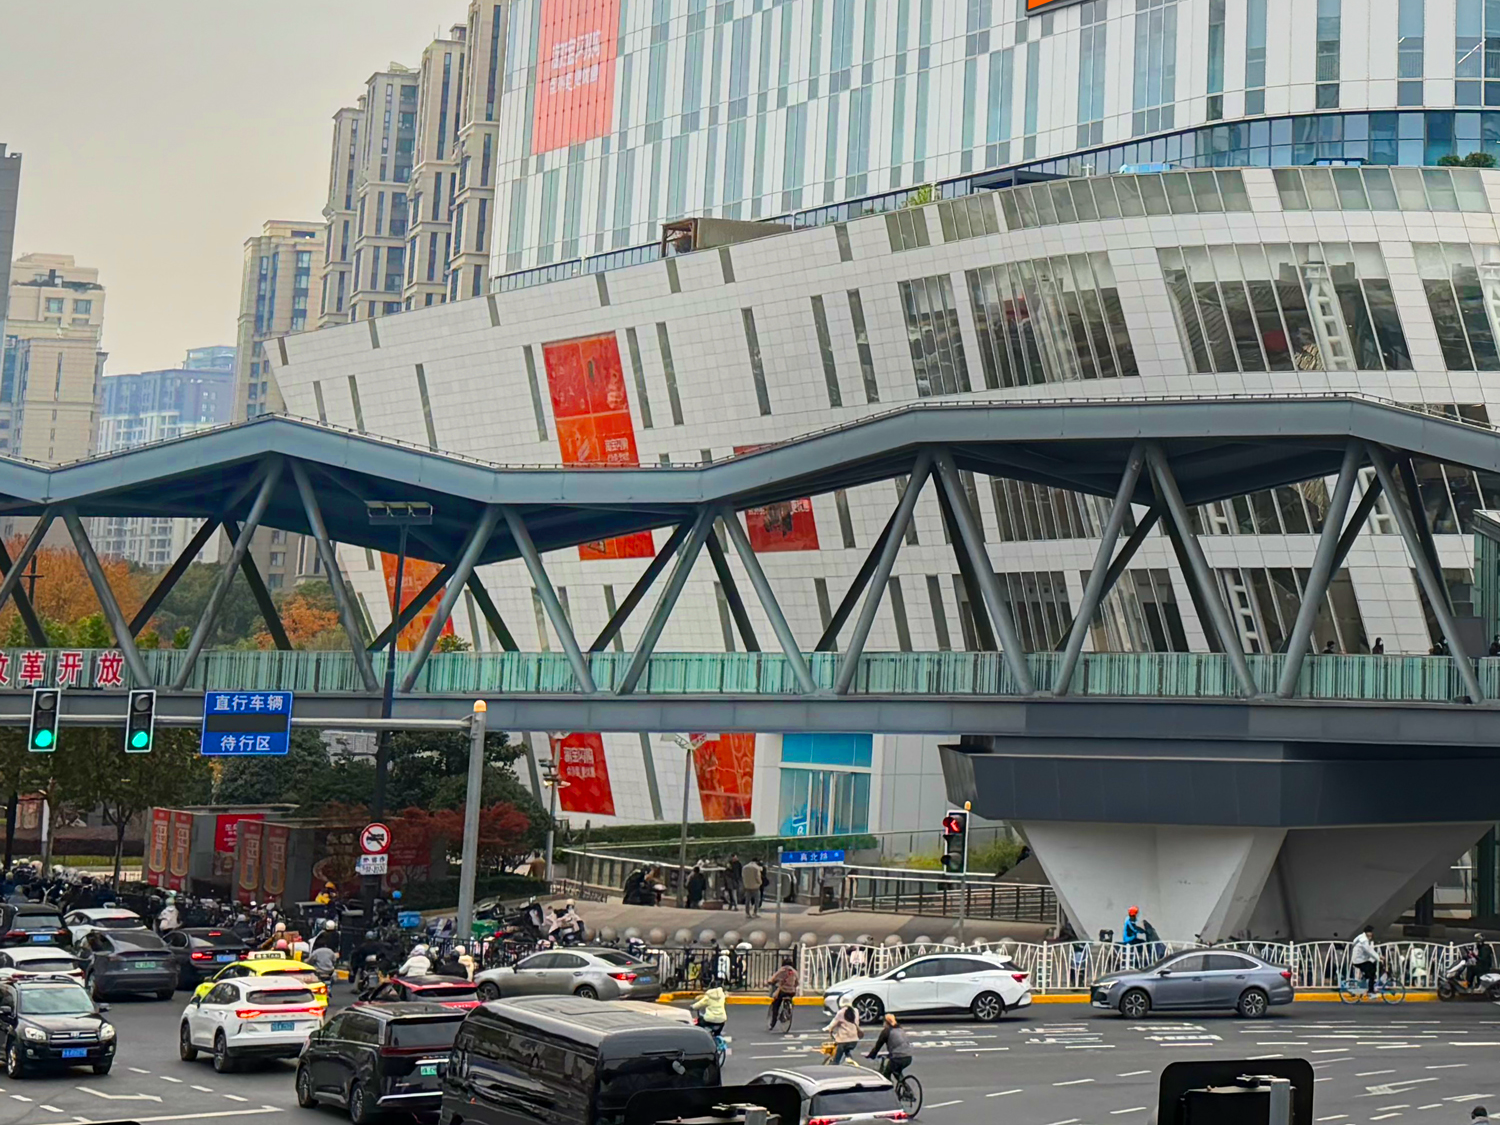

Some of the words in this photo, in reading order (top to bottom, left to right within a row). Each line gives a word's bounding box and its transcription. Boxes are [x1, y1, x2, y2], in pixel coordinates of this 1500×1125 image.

[213, 694, 284, 712] 直行车辆
[220, 735, 272, 752] 待行区
